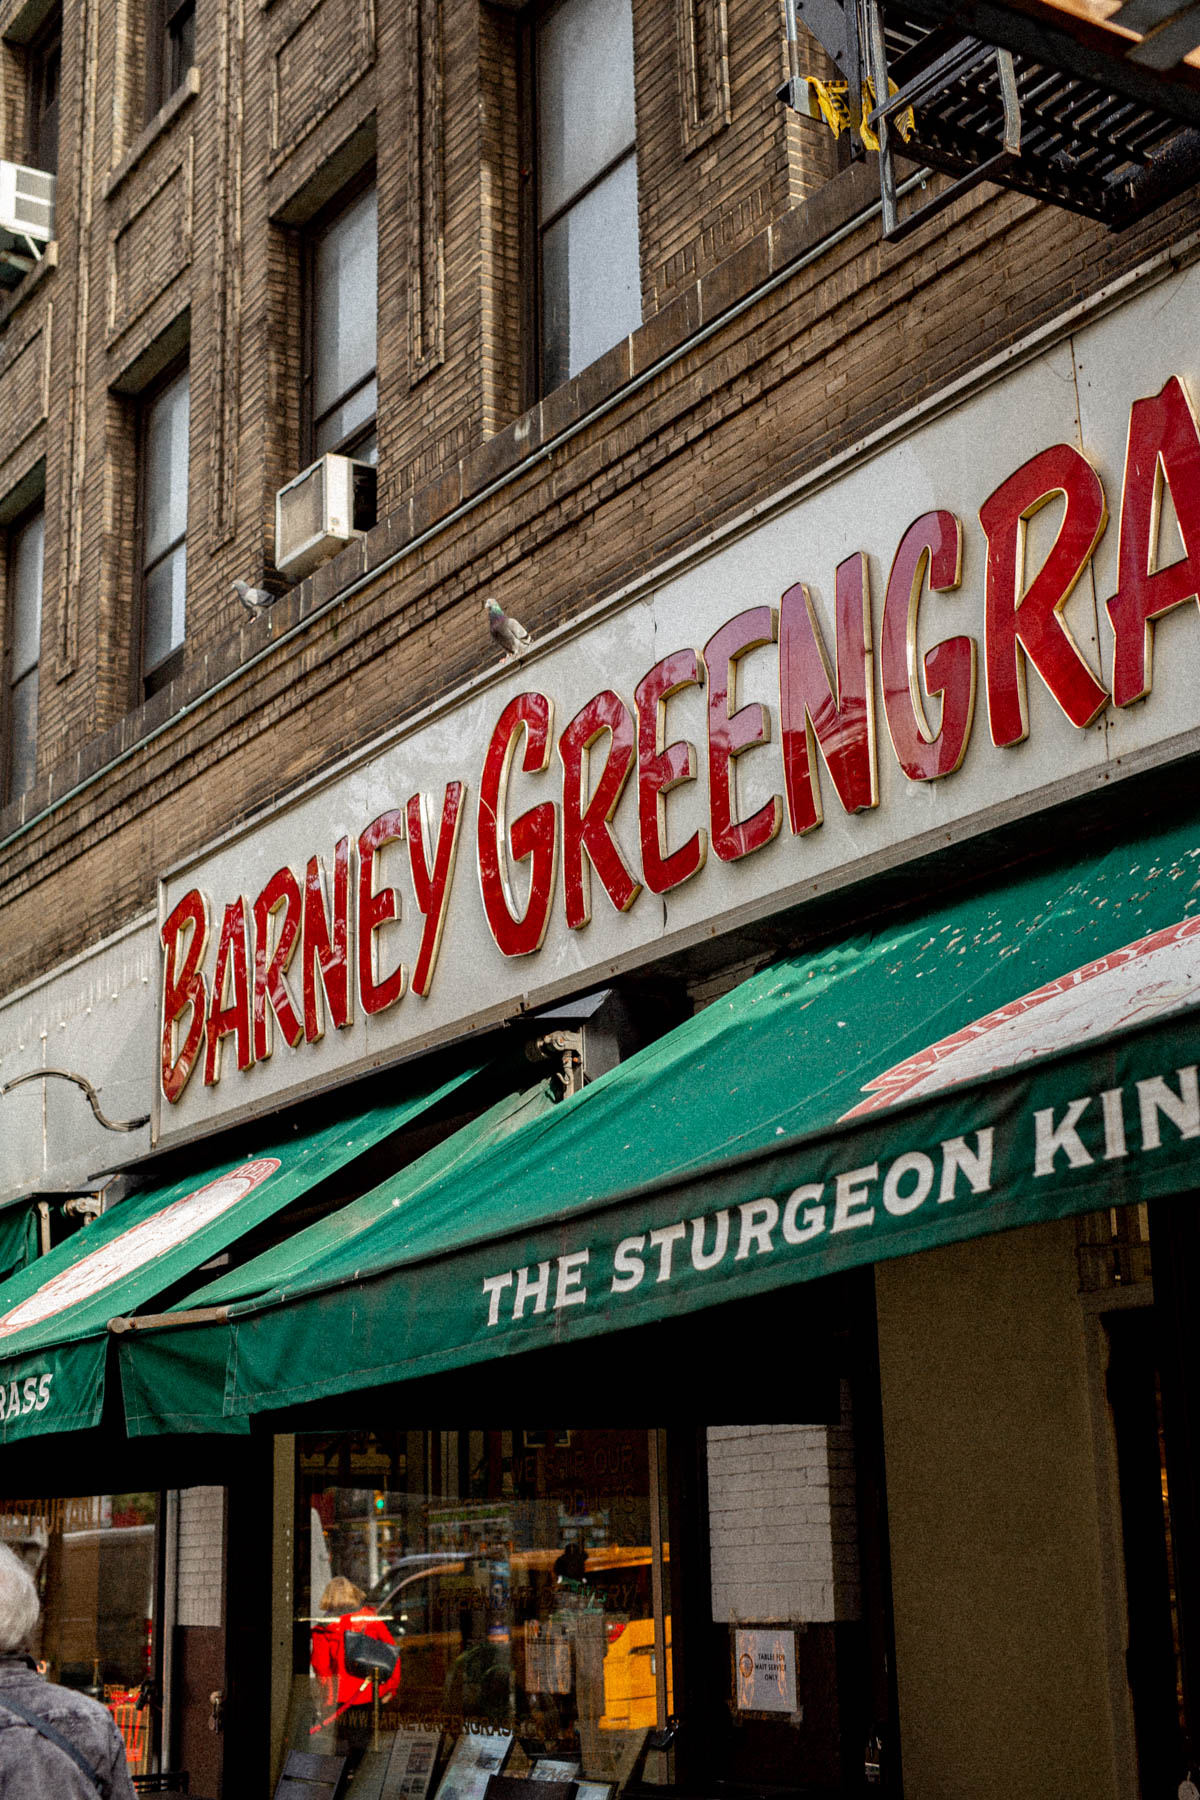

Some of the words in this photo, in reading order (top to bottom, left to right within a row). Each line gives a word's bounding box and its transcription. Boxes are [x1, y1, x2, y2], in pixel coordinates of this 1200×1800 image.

[160, 781, 469, 1105] BARNEY
[482, 1247, 589, 1326] THE
[610, 1126, 995, 1294] STURGEON
